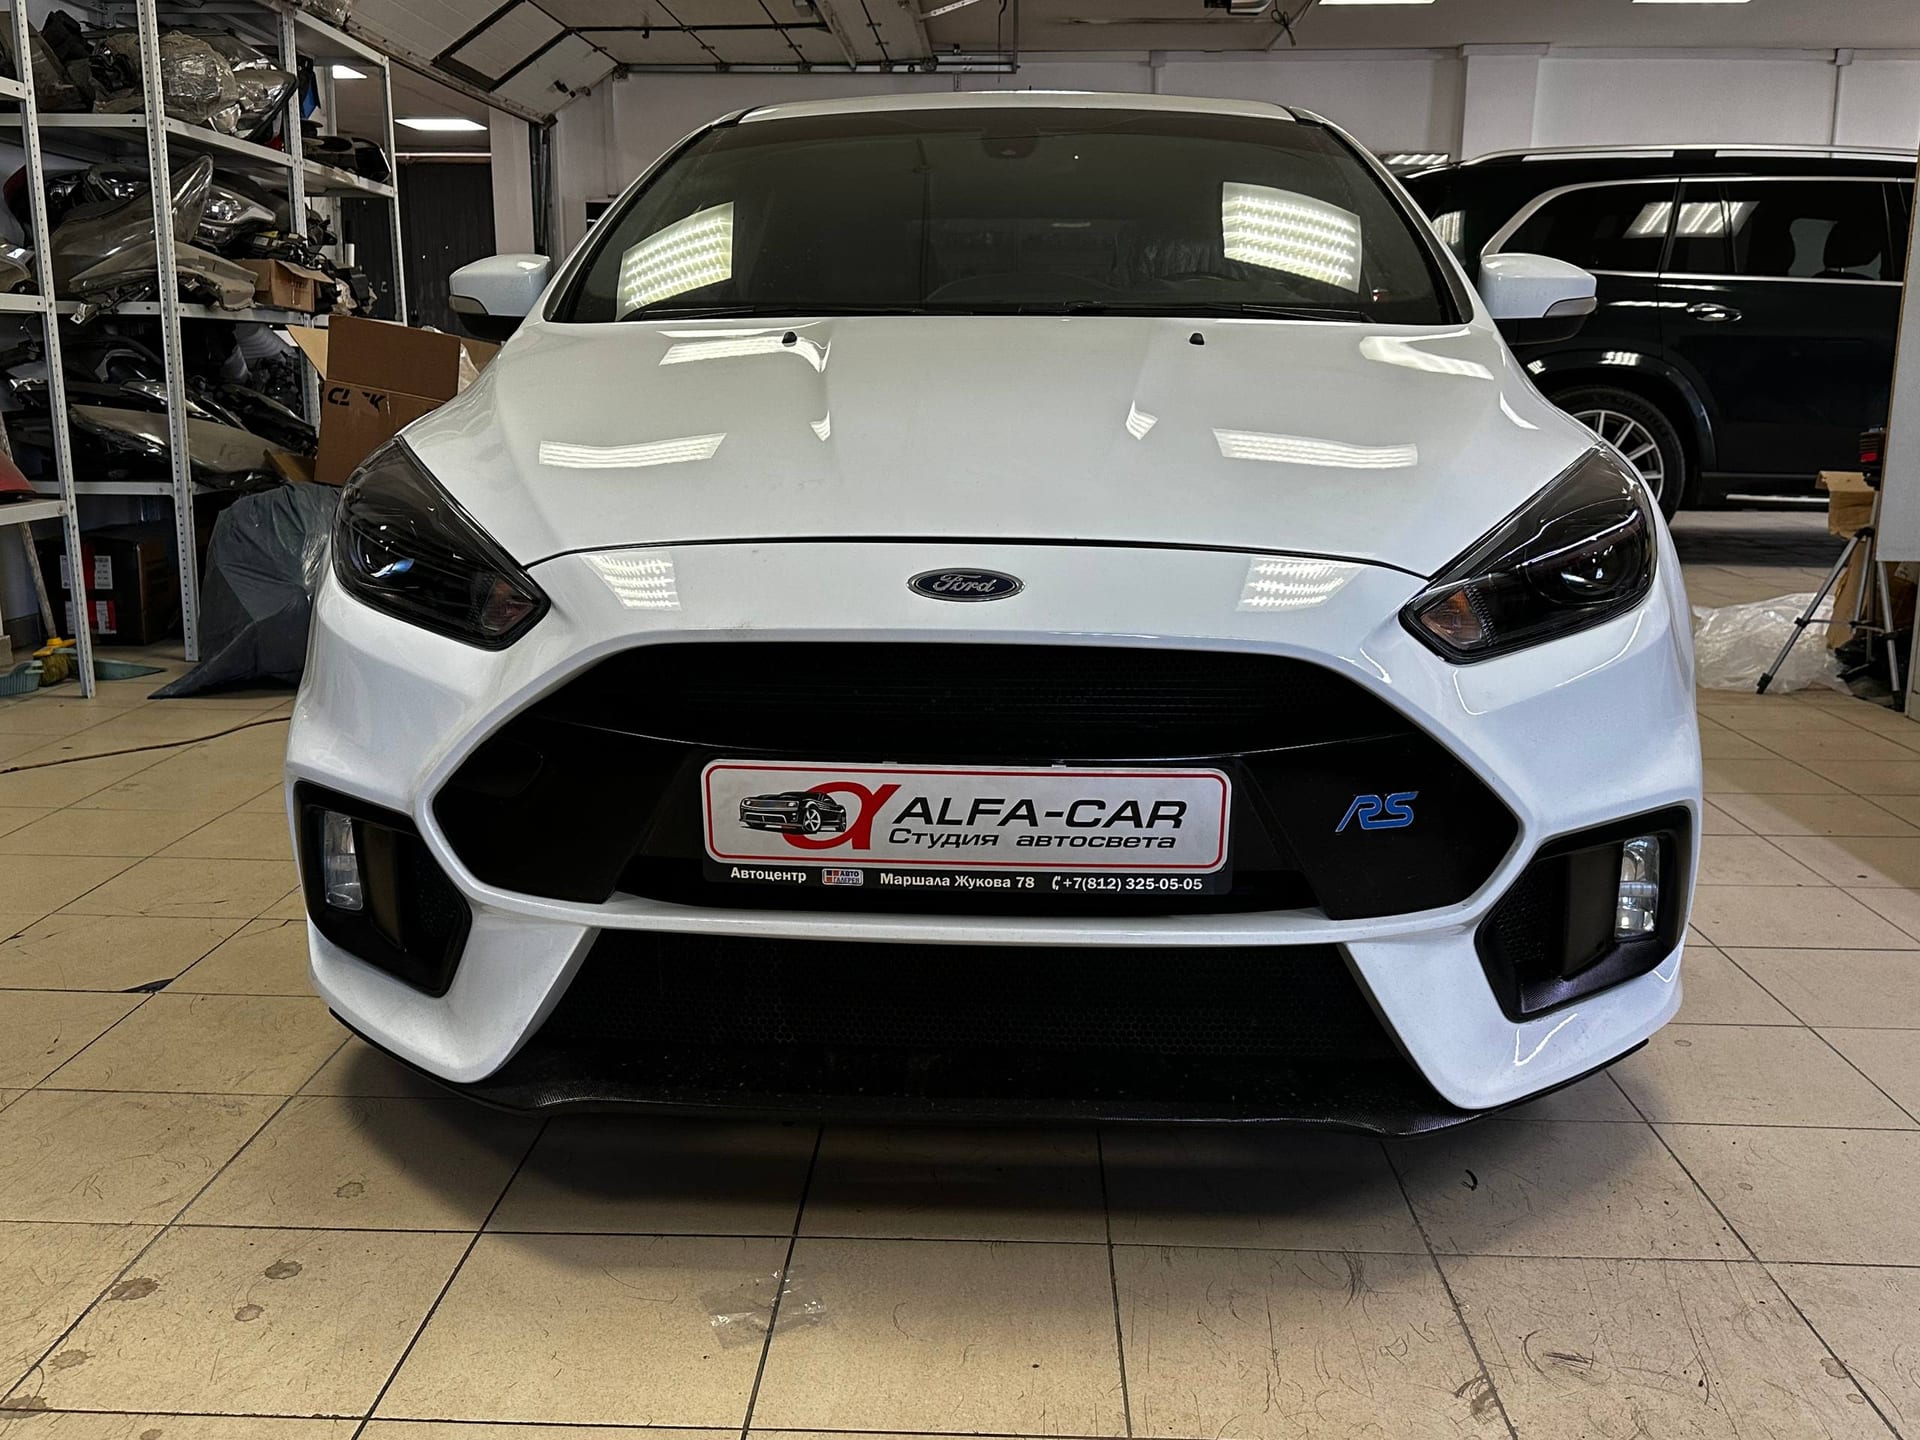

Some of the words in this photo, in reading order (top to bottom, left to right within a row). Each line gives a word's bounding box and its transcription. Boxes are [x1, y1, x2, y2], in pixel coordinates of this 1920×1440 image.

[932, 573, 997, 592] Ford
[892, 796, 1188, 829] ALFA-CAR
[1335, 791, 1420, 832] RS
[888, 828, 1000, 849] Студия
[1016, 834, 1177, 849] автосвета
[730, 867, 807, 884] Автоцентр
[880, 873, 950, 887] Маршала
[954, 875, 1011, 889] Жукова
[1015, 876, 1035, 888] 78
[1063, 877, 1122, 891] +7(812)
[1125, 878, 1203, 890] 325-05-05
